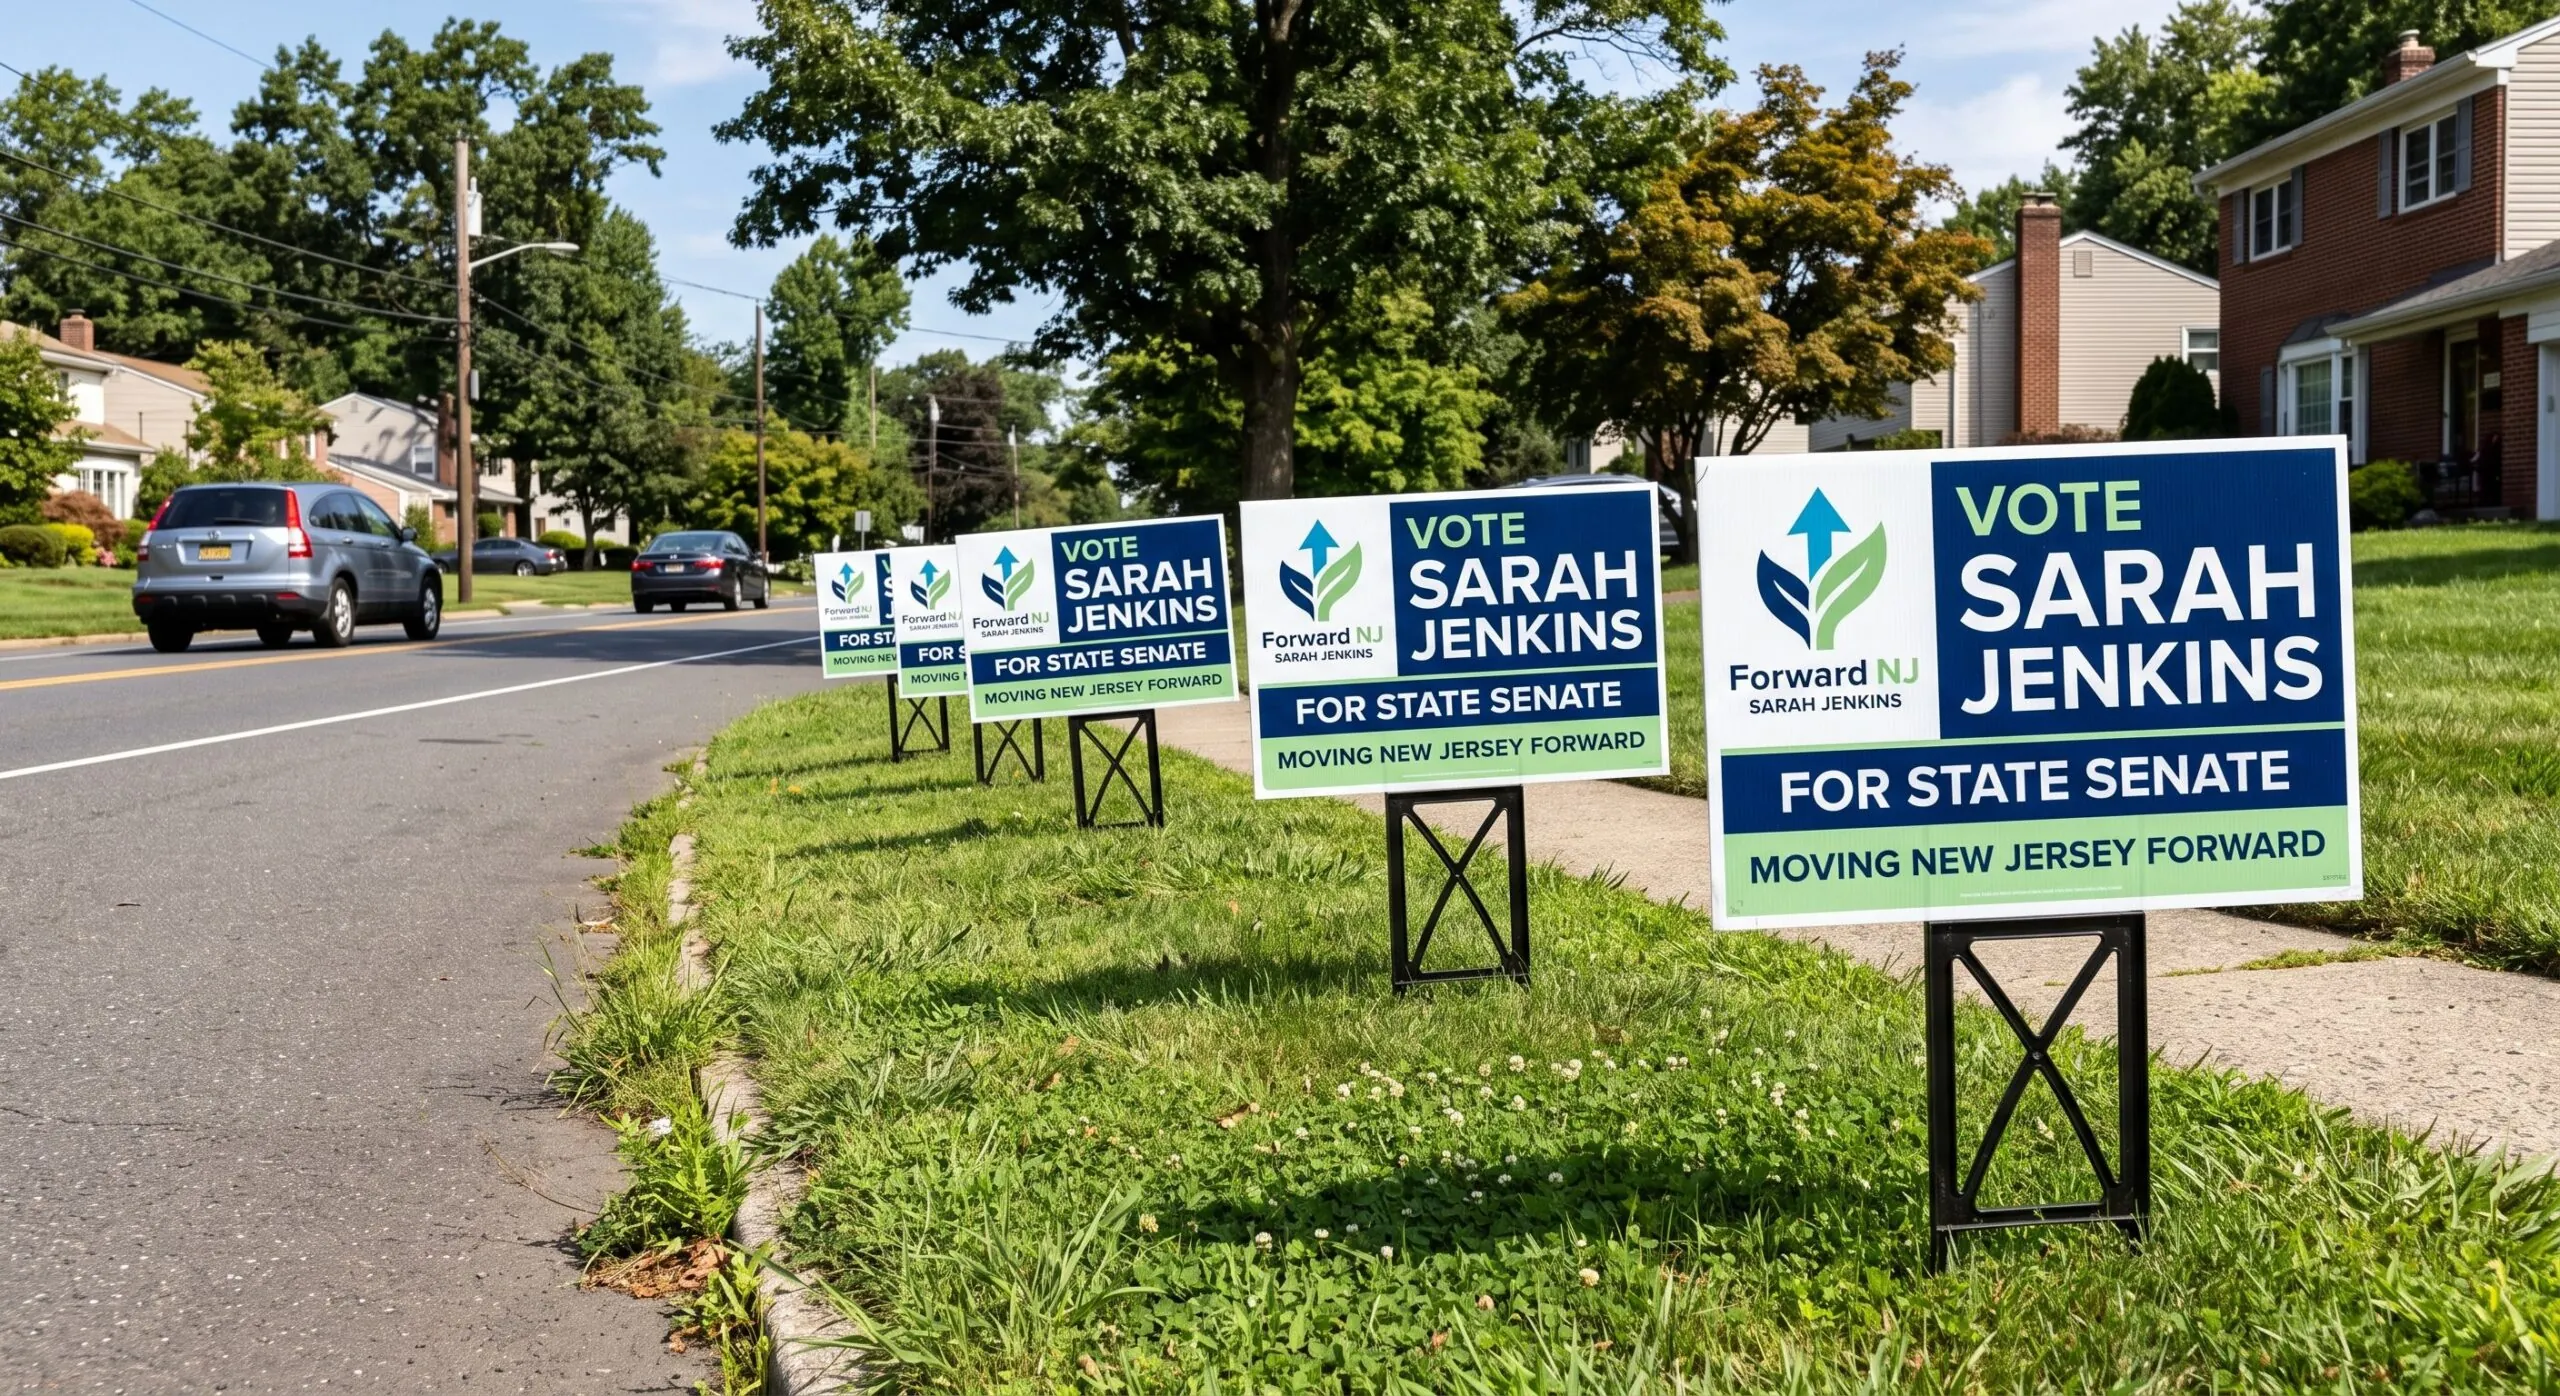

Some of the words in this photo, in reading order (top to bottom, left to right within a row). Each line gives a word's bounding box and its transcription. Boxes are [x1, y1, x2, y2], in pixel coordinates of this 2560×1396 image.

[1956, 480, 2141, 536] VOTE
[1406, 512, 1525, 549] VOTE
[1061, 536, 1138, 562] VOTE
[1065, 557, 1212, 600] SARAH
[1410, 551, 1637, 609] SARAH
[1960, 543, 2315, 632] SARAH
[902, 612, 946, 624] Forward
[973, 613, 1028, 629] Forward
[1032, 612, 1049, 624] NJ
[1068, 595, 1217, 633] JENKINS
[840, 633, 869, 646] FOR
[1011, 627, 1043, 635] JENKINS
[1263, 628, 1350, 648] Forward
[1357, 626, 1382, 643] NJ
[1412, 609, 1642, 660] JENKINS
[834, 655, 875, 665] MOVING
[919, 647, 953, 661] FOR
[995, 656, 1040, 675] FOR
[1047, 650, 1114, 671] STATE
[1121, 642, 1206, 665] SENATE
[1275, 652, 1317, 663] SARAH
[1322, 649, 1372, 660] JENKINS
[912, 672, 959, 683] MOVING
[985, 689, 1046, 704] MOVING
[1051, 685, 1084, 699] NEW
[1090, 680, 1143, 695] JERSEY
[1148, 674, 1222, 690] FORWARD
[1730, 660, 1866, 690] Forward
[1878, 658, 1918, 684] NJ
[1961, 636, 2322, 714] JENKINS
[1297, 696, 1366, 724] FOR
[1377, 689, 1480, 719] STATE
[1491, 681, 1621, 713] SENATE
[1750, 697, 1815, 714] SARAH
[1822, 693, 1901, 710] JENKINS
[1279, 747, 1372, 769] MOVING
[1380, 743, 1432, 763] NEW
[1440, 738, 1523, 759] JERSEY
[1531, 732, 1645, 754] FORWARD
[1782, 769, 1890, 812] FOR
[1908, 760, 2069, 807] STATE
[2086, 750, 2289, 798] SENATE
[1751, 850, 1899, 883] MOVING
[1913, 845, 1993, 875] NEW
[2005, 839, 2136, 871] JERSEY
[2148, 830, 2325, 864] FORWARD
